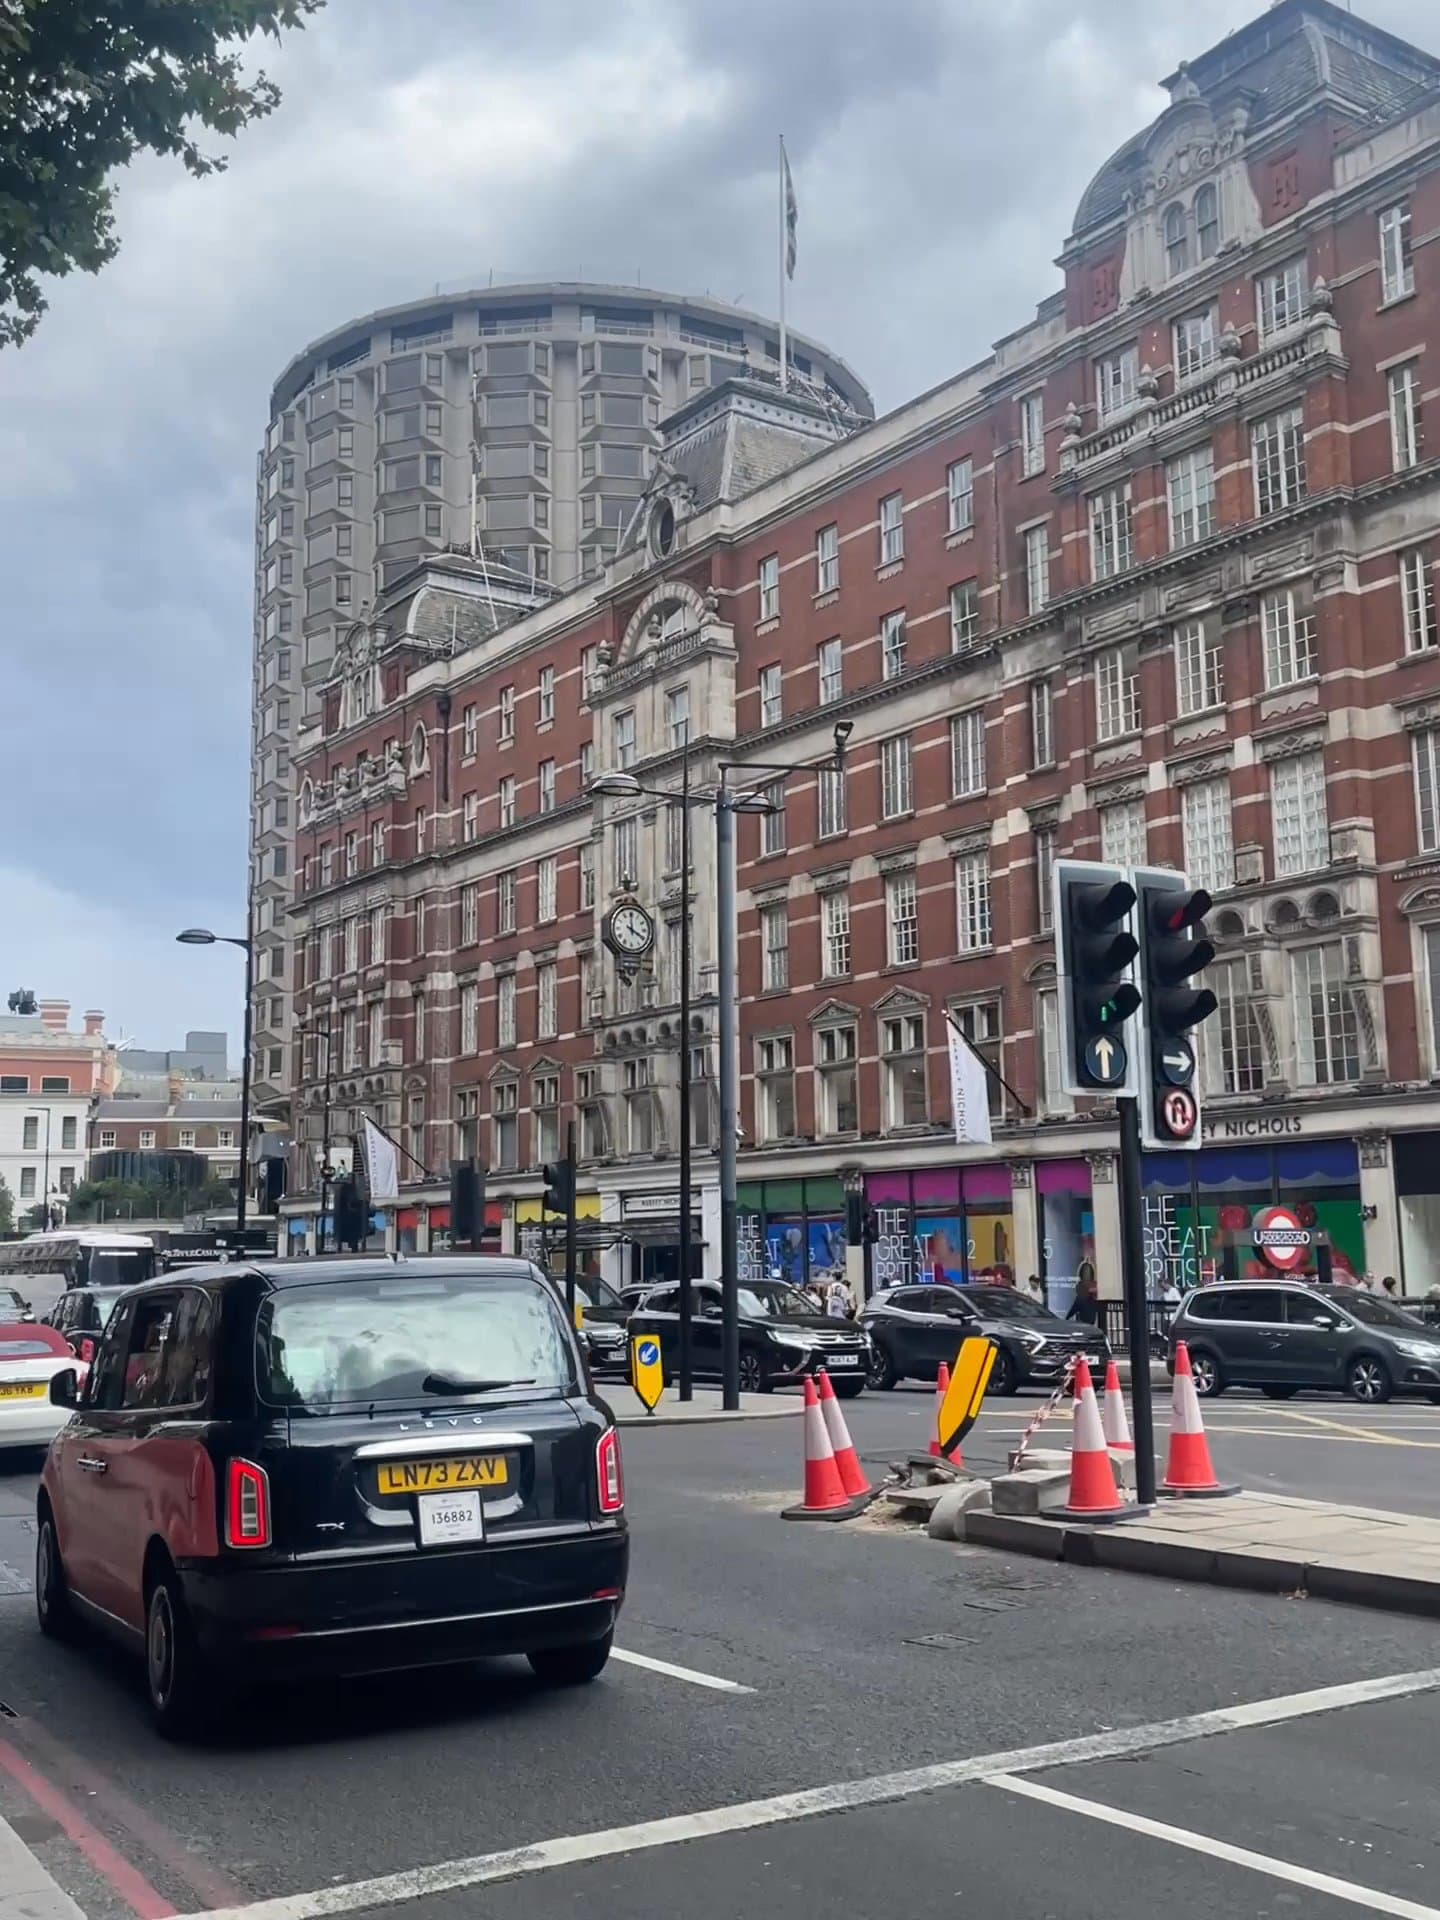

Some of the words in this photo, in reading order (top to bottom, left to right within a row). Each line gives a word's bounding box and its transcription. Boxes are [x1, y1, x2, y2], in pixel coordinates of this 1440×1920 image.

[1225, 1116, 1302, 1137] NICHOLS
[875, 1207, 907, 1234] THE
[808, 1247, 816, 1262] 3
[875, 1233, 933, 1261] GREAT
[967, 1239, 977, 1260] 2
[388, 1461, 449, 1488] LN73
[455, 1457, 497, 1482] ZXV
[431, 1510, 473, 1525] 136882
